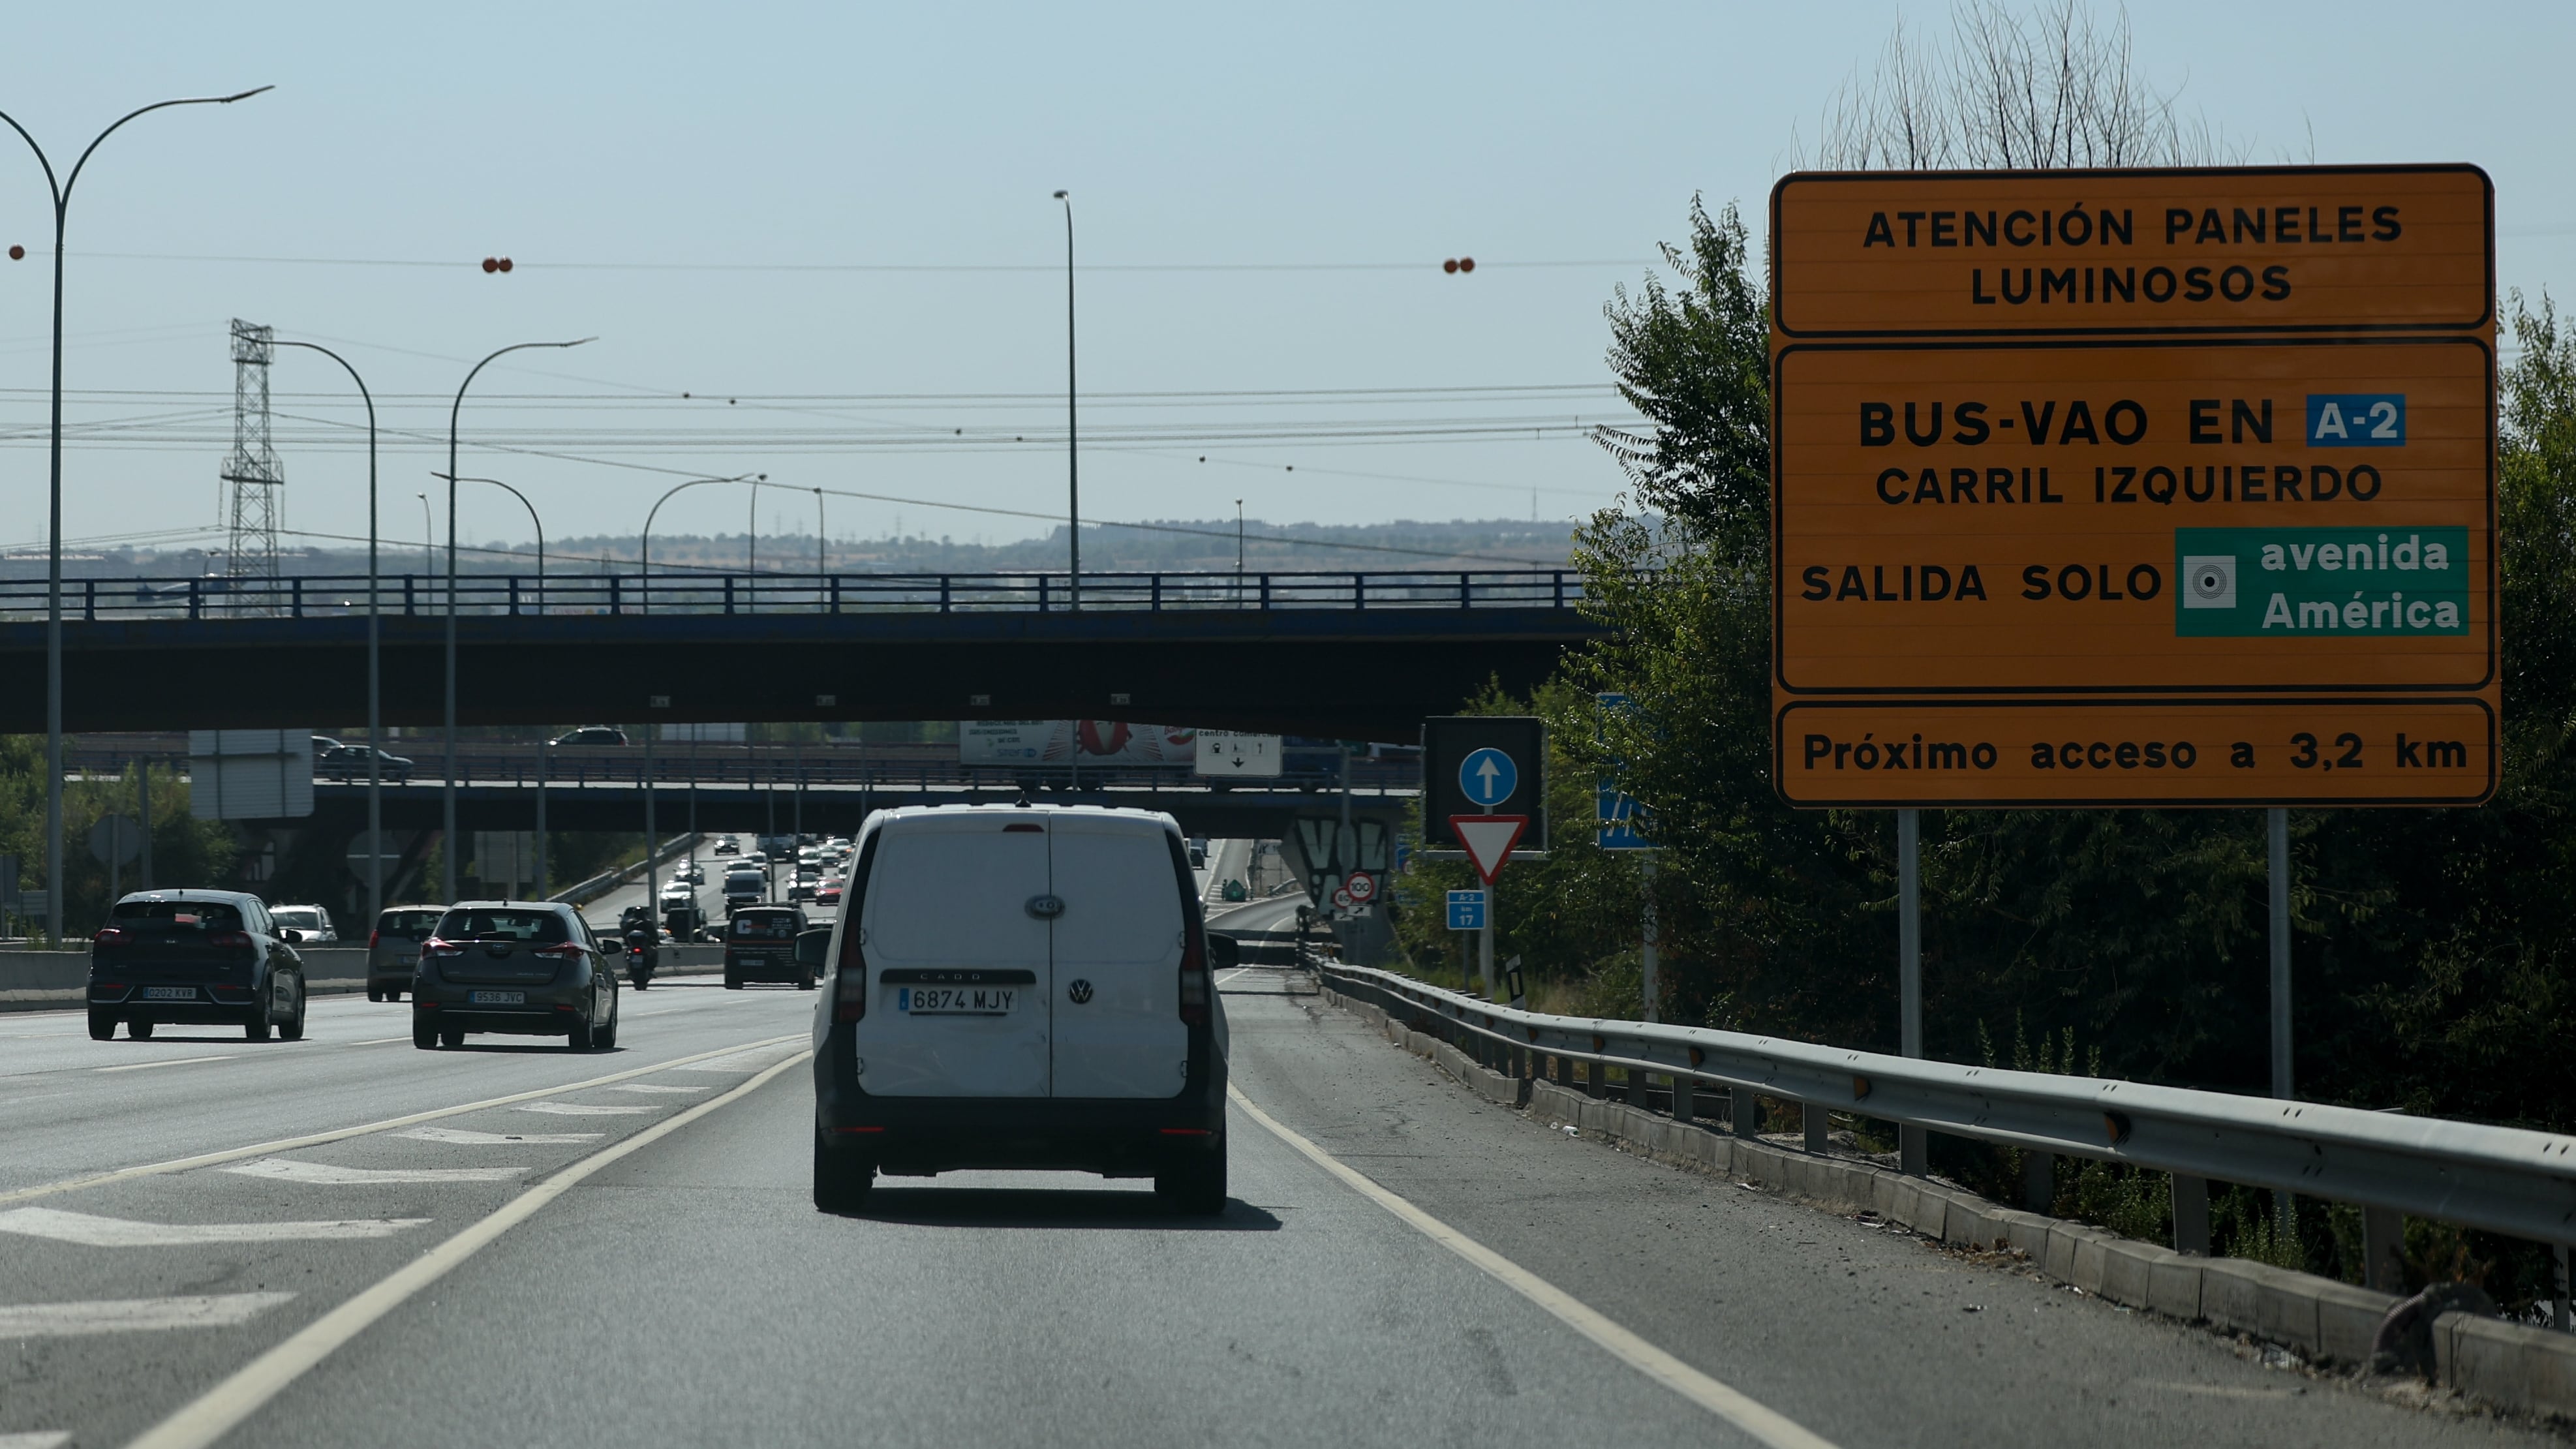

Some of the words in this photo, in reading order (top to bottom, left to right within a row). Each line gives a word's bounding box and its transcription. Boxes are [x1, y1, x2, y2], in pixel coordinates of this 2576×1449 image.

[1863, 202, 2132, 247] ATENCIÓN
[2166, 206, 2402, 244] PANELES
[1973, 266, 2292, 305] LUMINOSOS
[1861, 400, 2147, 447] BUS-VAO
[2190, 400, 2272, 444] EN
[2315, 402, 2398, 439] A-2
[1877, 468, 2062, 504] CARRIL
[2096, 466, 2381, 507] IZQUIERDO
[2262, 534, 2449, 571] avenida
[1802, 566, 1987, 601] SALIDA
[2021, 564, 2161, 601] SOLO
[2262, 591, 2460, 628] América
[1805, 733, 1997, 770] Próximo
[2031, 742, 2197, 769] acceso
[2230, 742, 2255, 768] a
[2290, 733, 2363, 772] 3,2
[2397, 733, 2467, 768] km
[1351, 882, 1370, 892] 100
[1459, 893, 1475, 902] A-2
[1459, 915, 1474, 926] 17
[149, 988, 173, 998] 0202
[175, 988, 194, 998] KVR
[476, 992, 500, 1002] 9536
[504, 992, 523, 1003] JVC
[913, 990, 966, 1009] 6874
[974, 990, 1013, 1009] MJY
